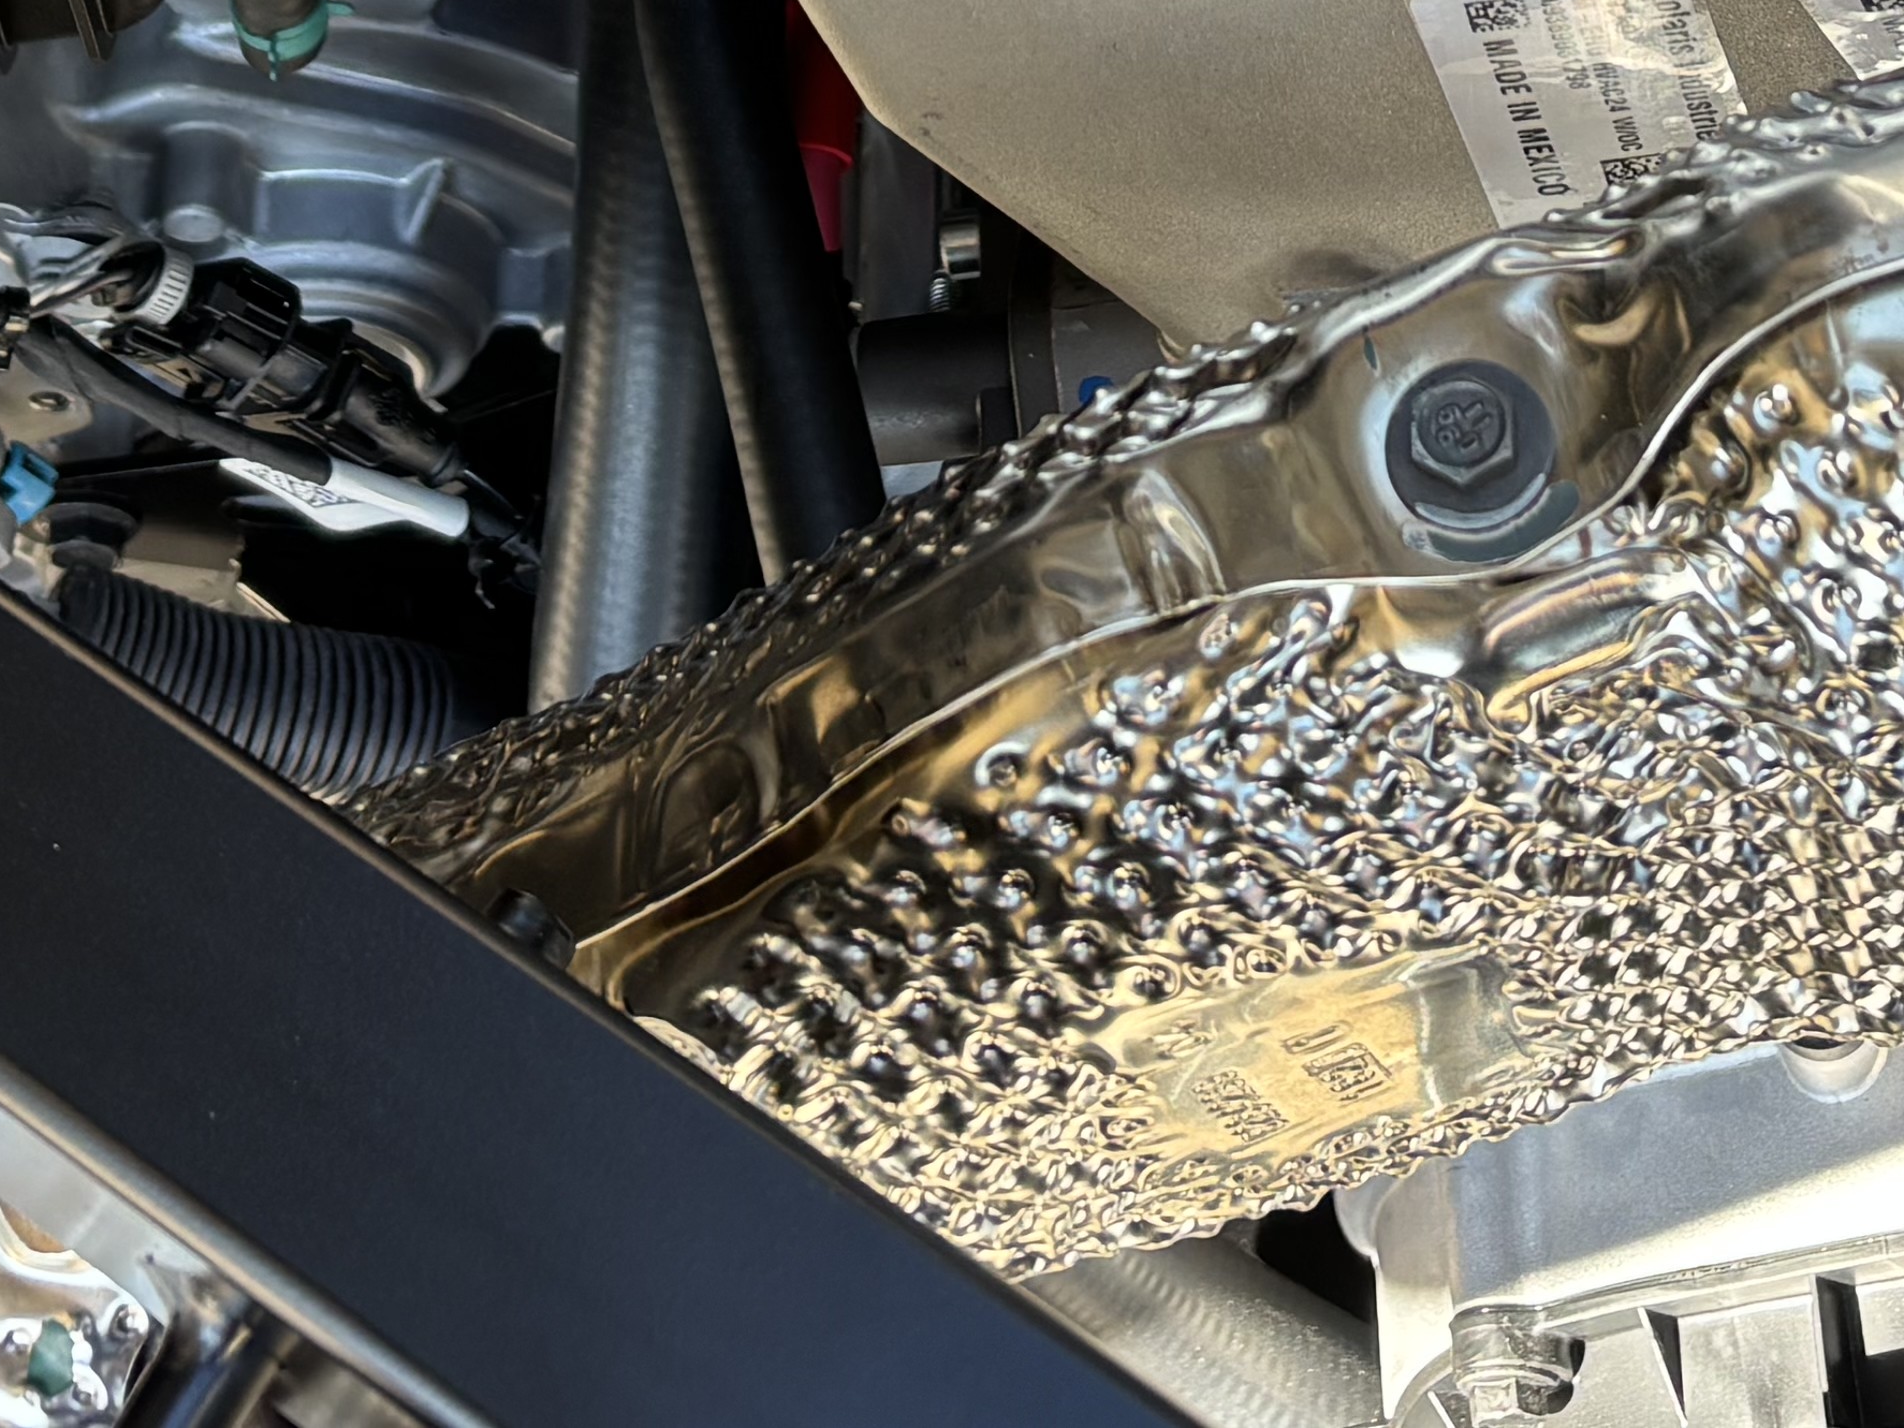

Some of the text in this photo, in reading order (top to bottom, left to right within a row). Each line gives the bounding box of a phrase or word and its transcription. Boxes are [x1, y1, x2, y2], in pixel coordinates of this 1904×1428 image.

[1483, 38, 1573, 197] MADE IN MEXICO
[1674, 60, 1720, 143] Idustrie
